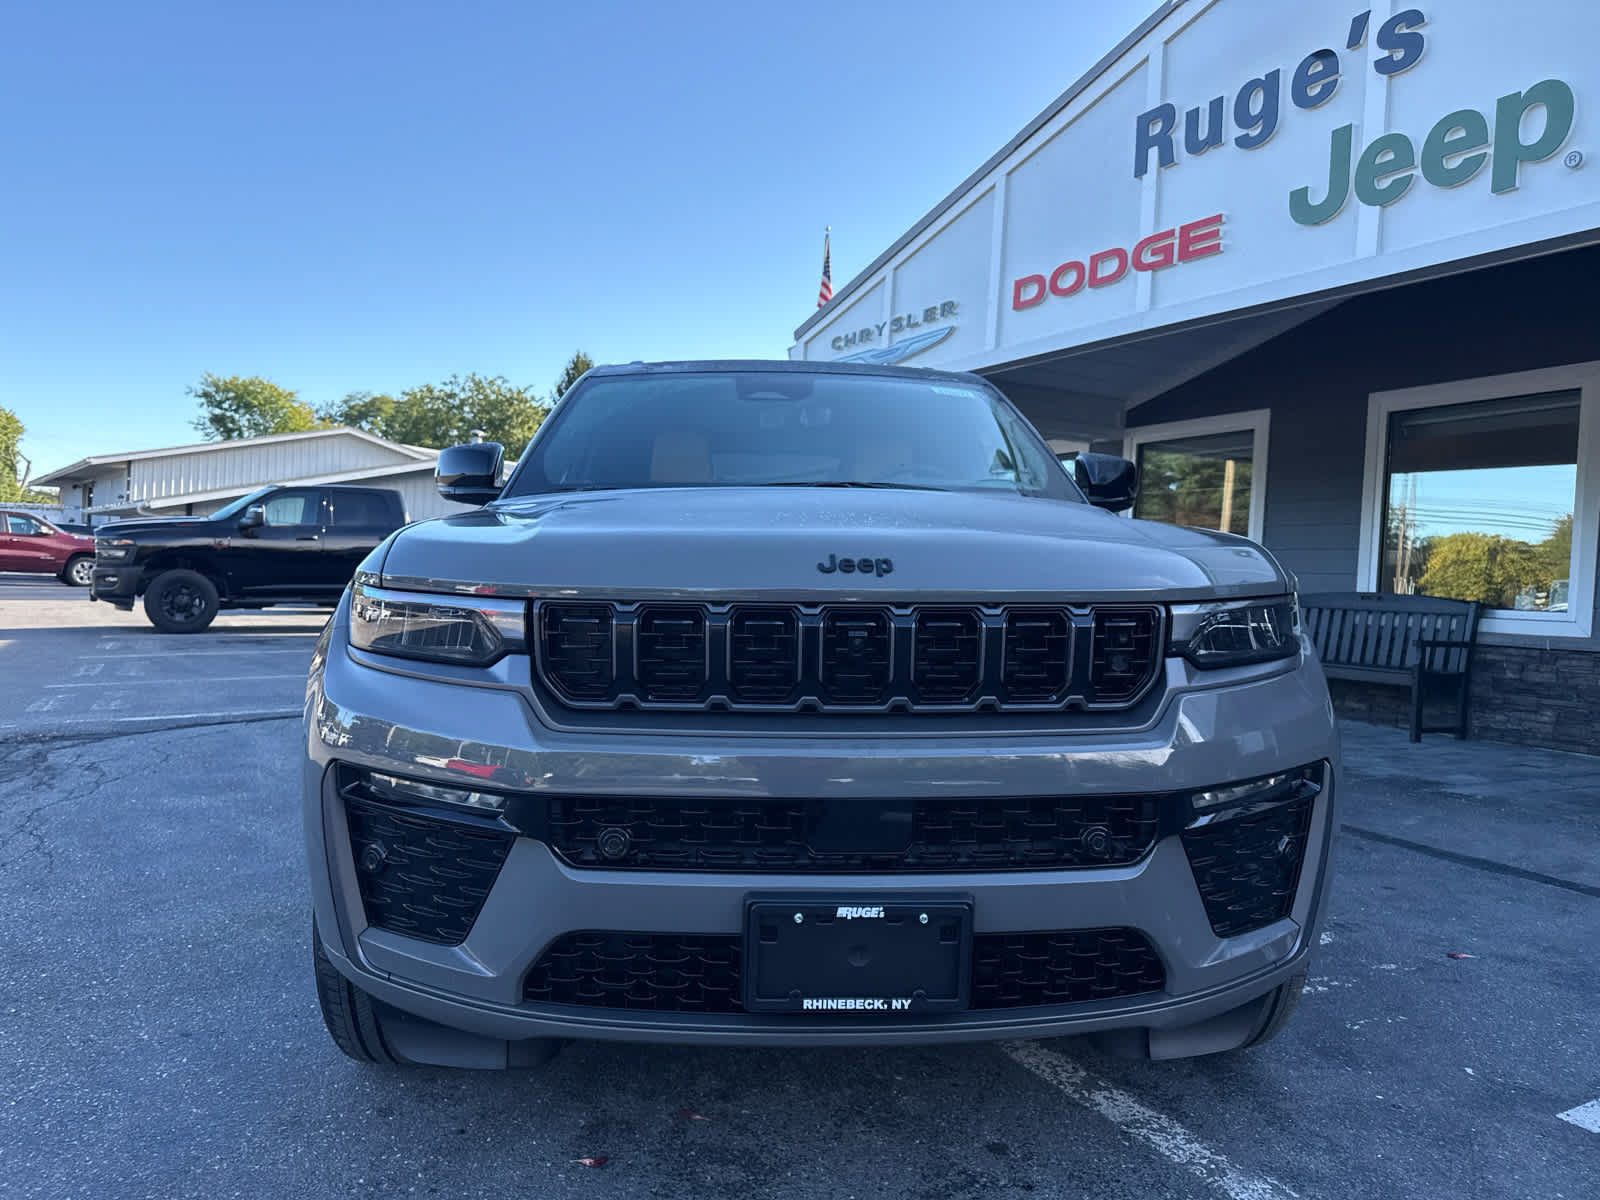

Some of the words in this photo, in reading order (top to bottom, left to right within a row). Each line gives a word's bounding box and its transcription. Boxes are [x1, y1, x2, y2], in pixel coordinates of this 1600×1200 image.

[1133, 8, 1427, 179] Ruge's
[1288, 78, 1576, 227] Jeep
[1012, 213, 1225, 311] DODGE
[831, 300, 957, 351] CHRYSLER
[816, 553, 894, 578] Jeep
[803, 998, 888, 1010] RHINEBECK,
[891, 998, 912, 1010] NY
